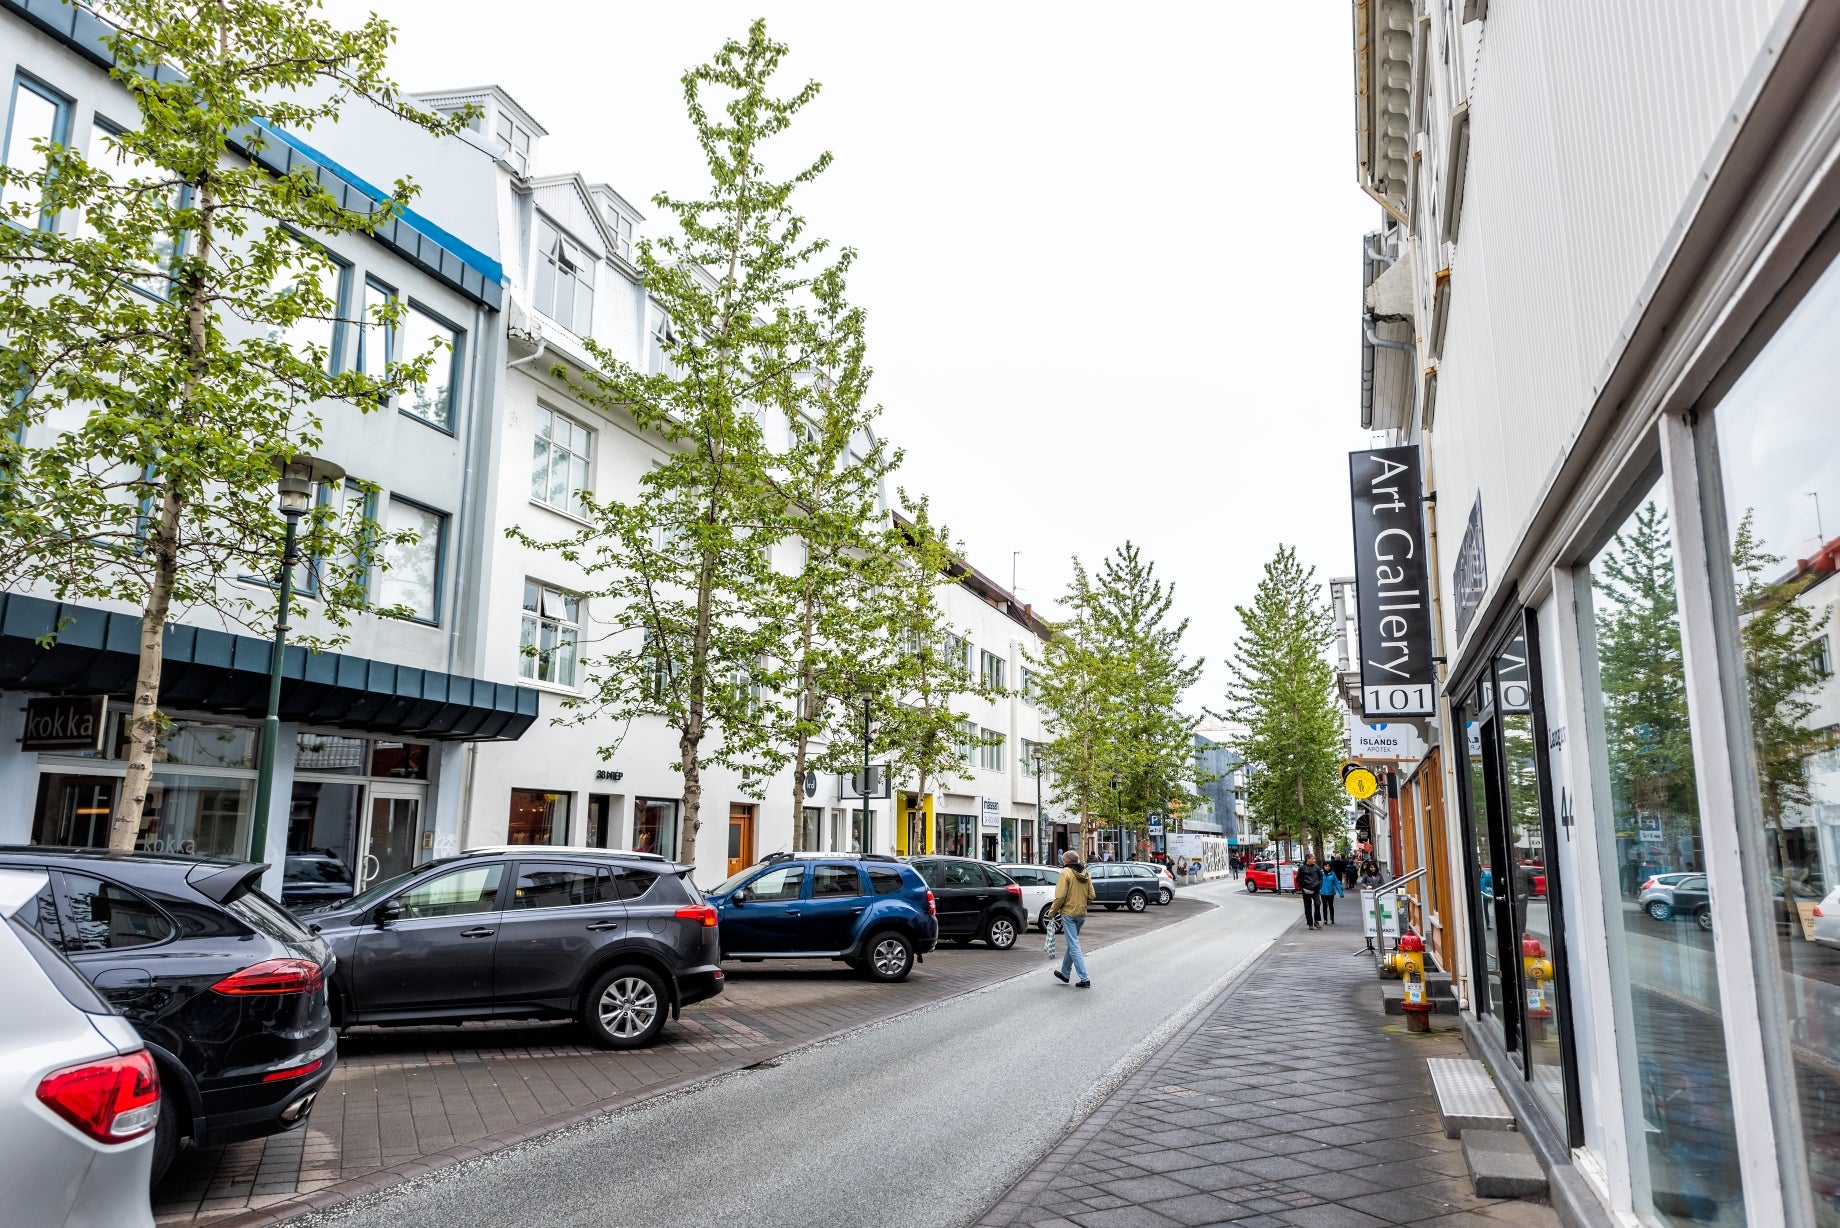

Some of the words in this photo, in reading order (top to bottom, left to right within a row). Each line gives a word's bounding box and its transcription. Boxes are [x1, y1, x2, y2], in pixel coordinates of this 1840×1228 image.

[1370, 455, 1409, 516] Art
[1368, 528, 1421, 679] Gallery
[1369, 688, 1425, 711] 101
[27, 706, 94, 737] kokka
[1151, 815, 1159, 824] P
[143, 832, 196, 854] kokka
